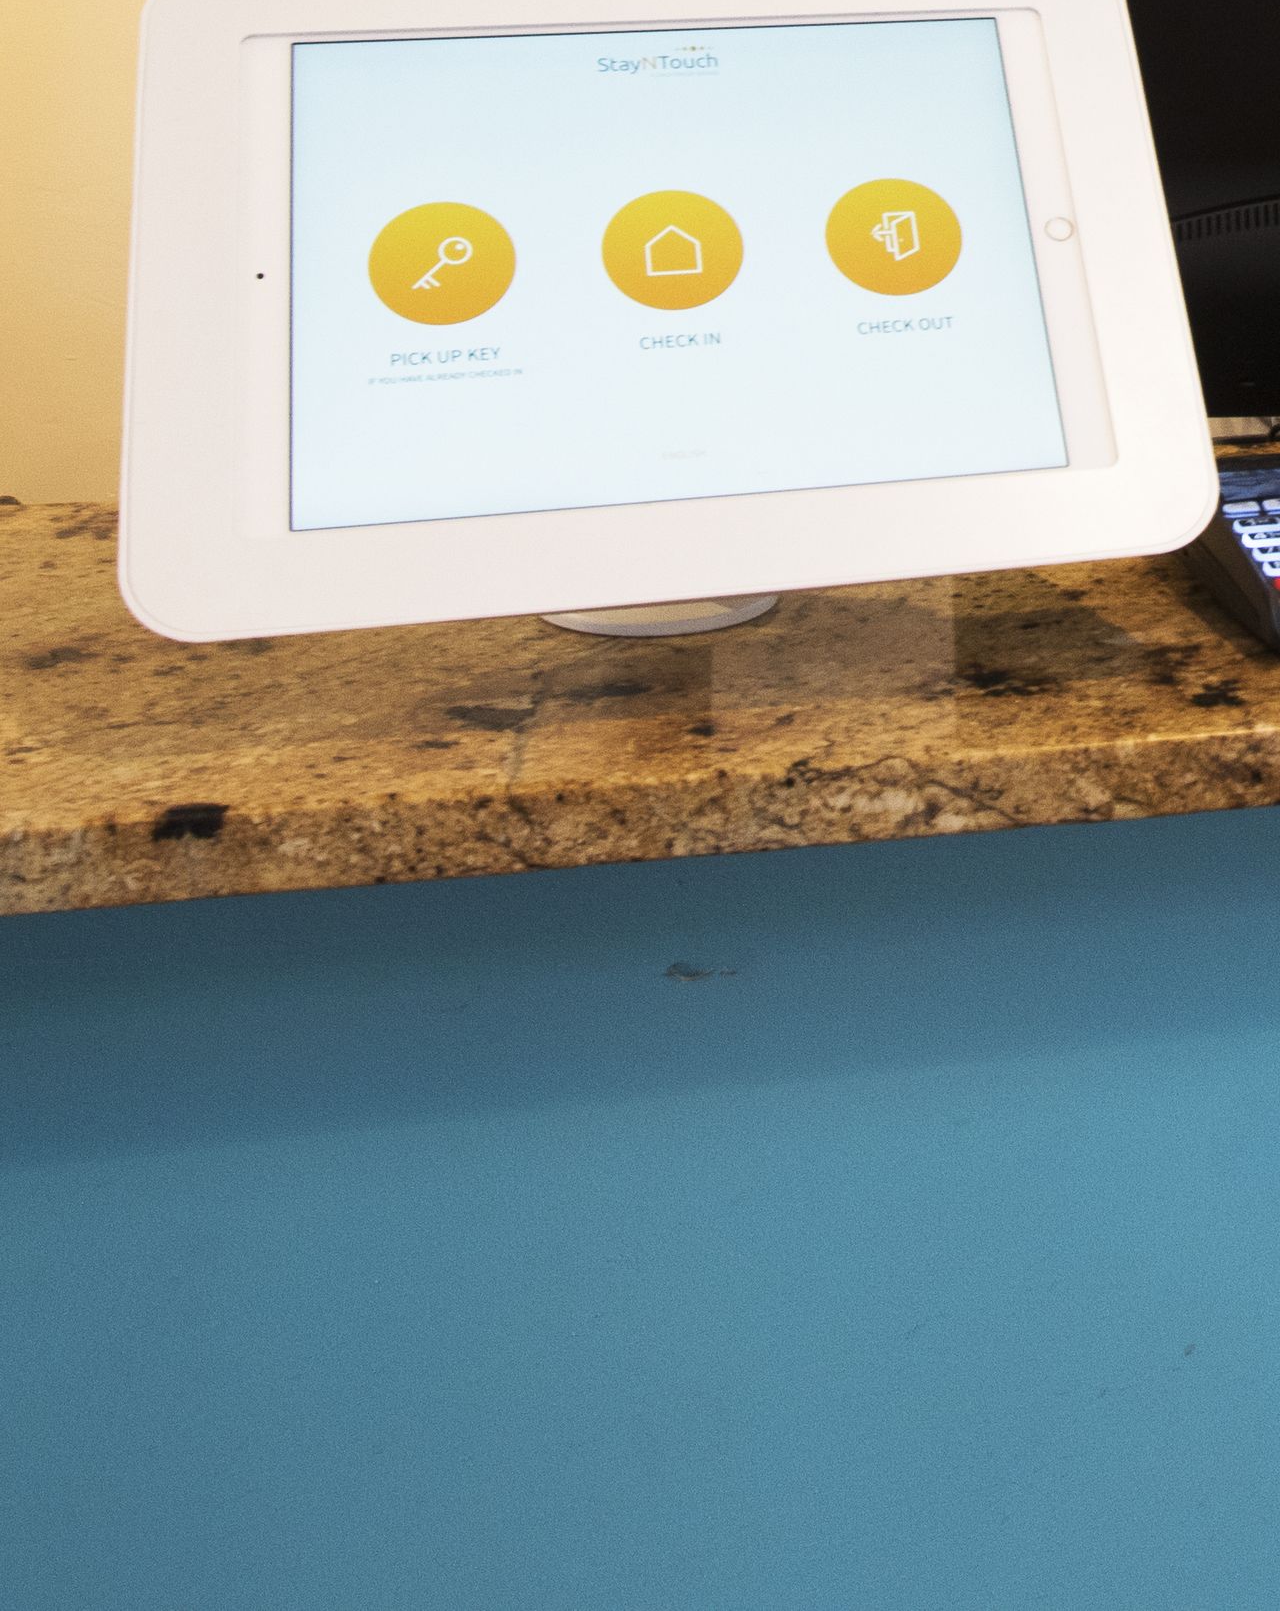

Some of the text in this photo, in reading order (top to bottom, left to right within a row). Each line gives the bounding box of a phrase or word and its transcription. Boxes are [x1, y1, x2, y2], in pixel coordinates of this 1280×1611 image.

[596, 52, 719, 75] StayNTouch
[856, 316, 954, 335] CHECK OUT
[639, 331, 722, 350] CHECK IN
[390, 346, 501, 366] PICK UP KEY
